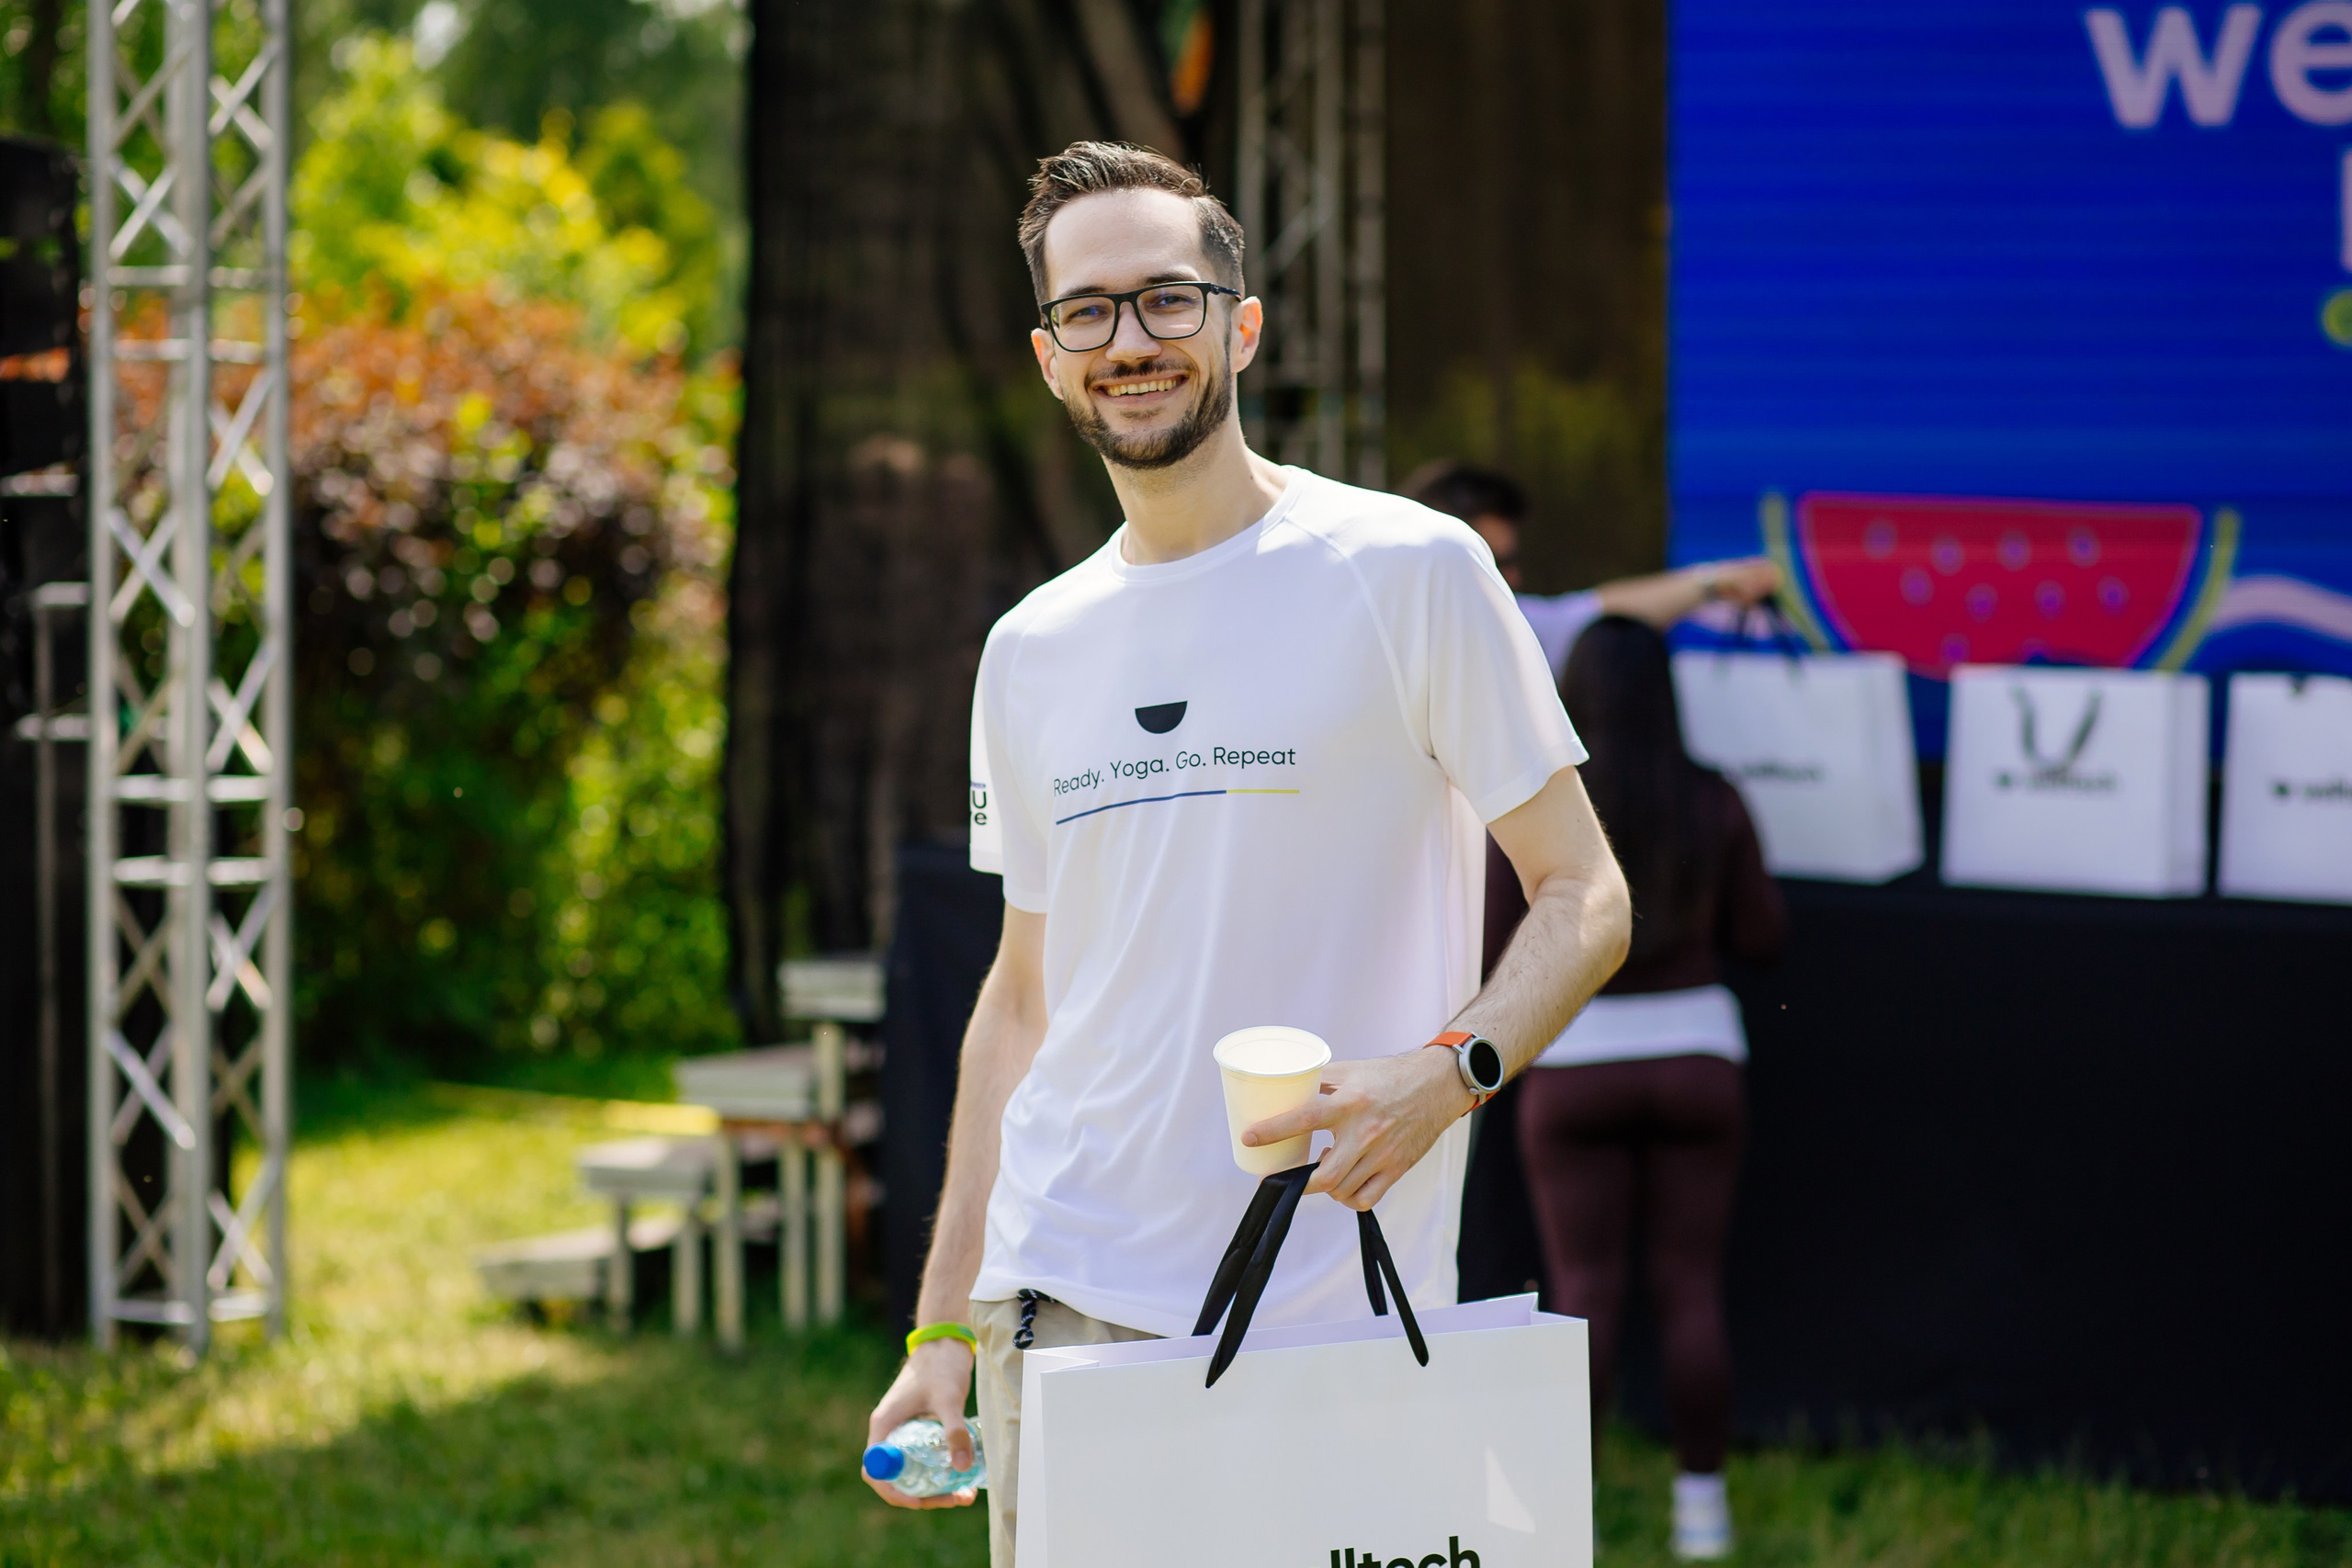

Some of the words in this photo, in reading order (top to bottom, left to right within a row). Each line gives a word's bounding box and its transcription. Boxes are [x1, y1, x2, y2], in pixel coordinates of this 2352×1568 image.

[1054, 768, 1104, 796] Ready.
[1110, 760, 1170, 780] Yoga.
[1176, 750, 1206, 770] Go.
[1214, 746, 1296, 770] Repeat
